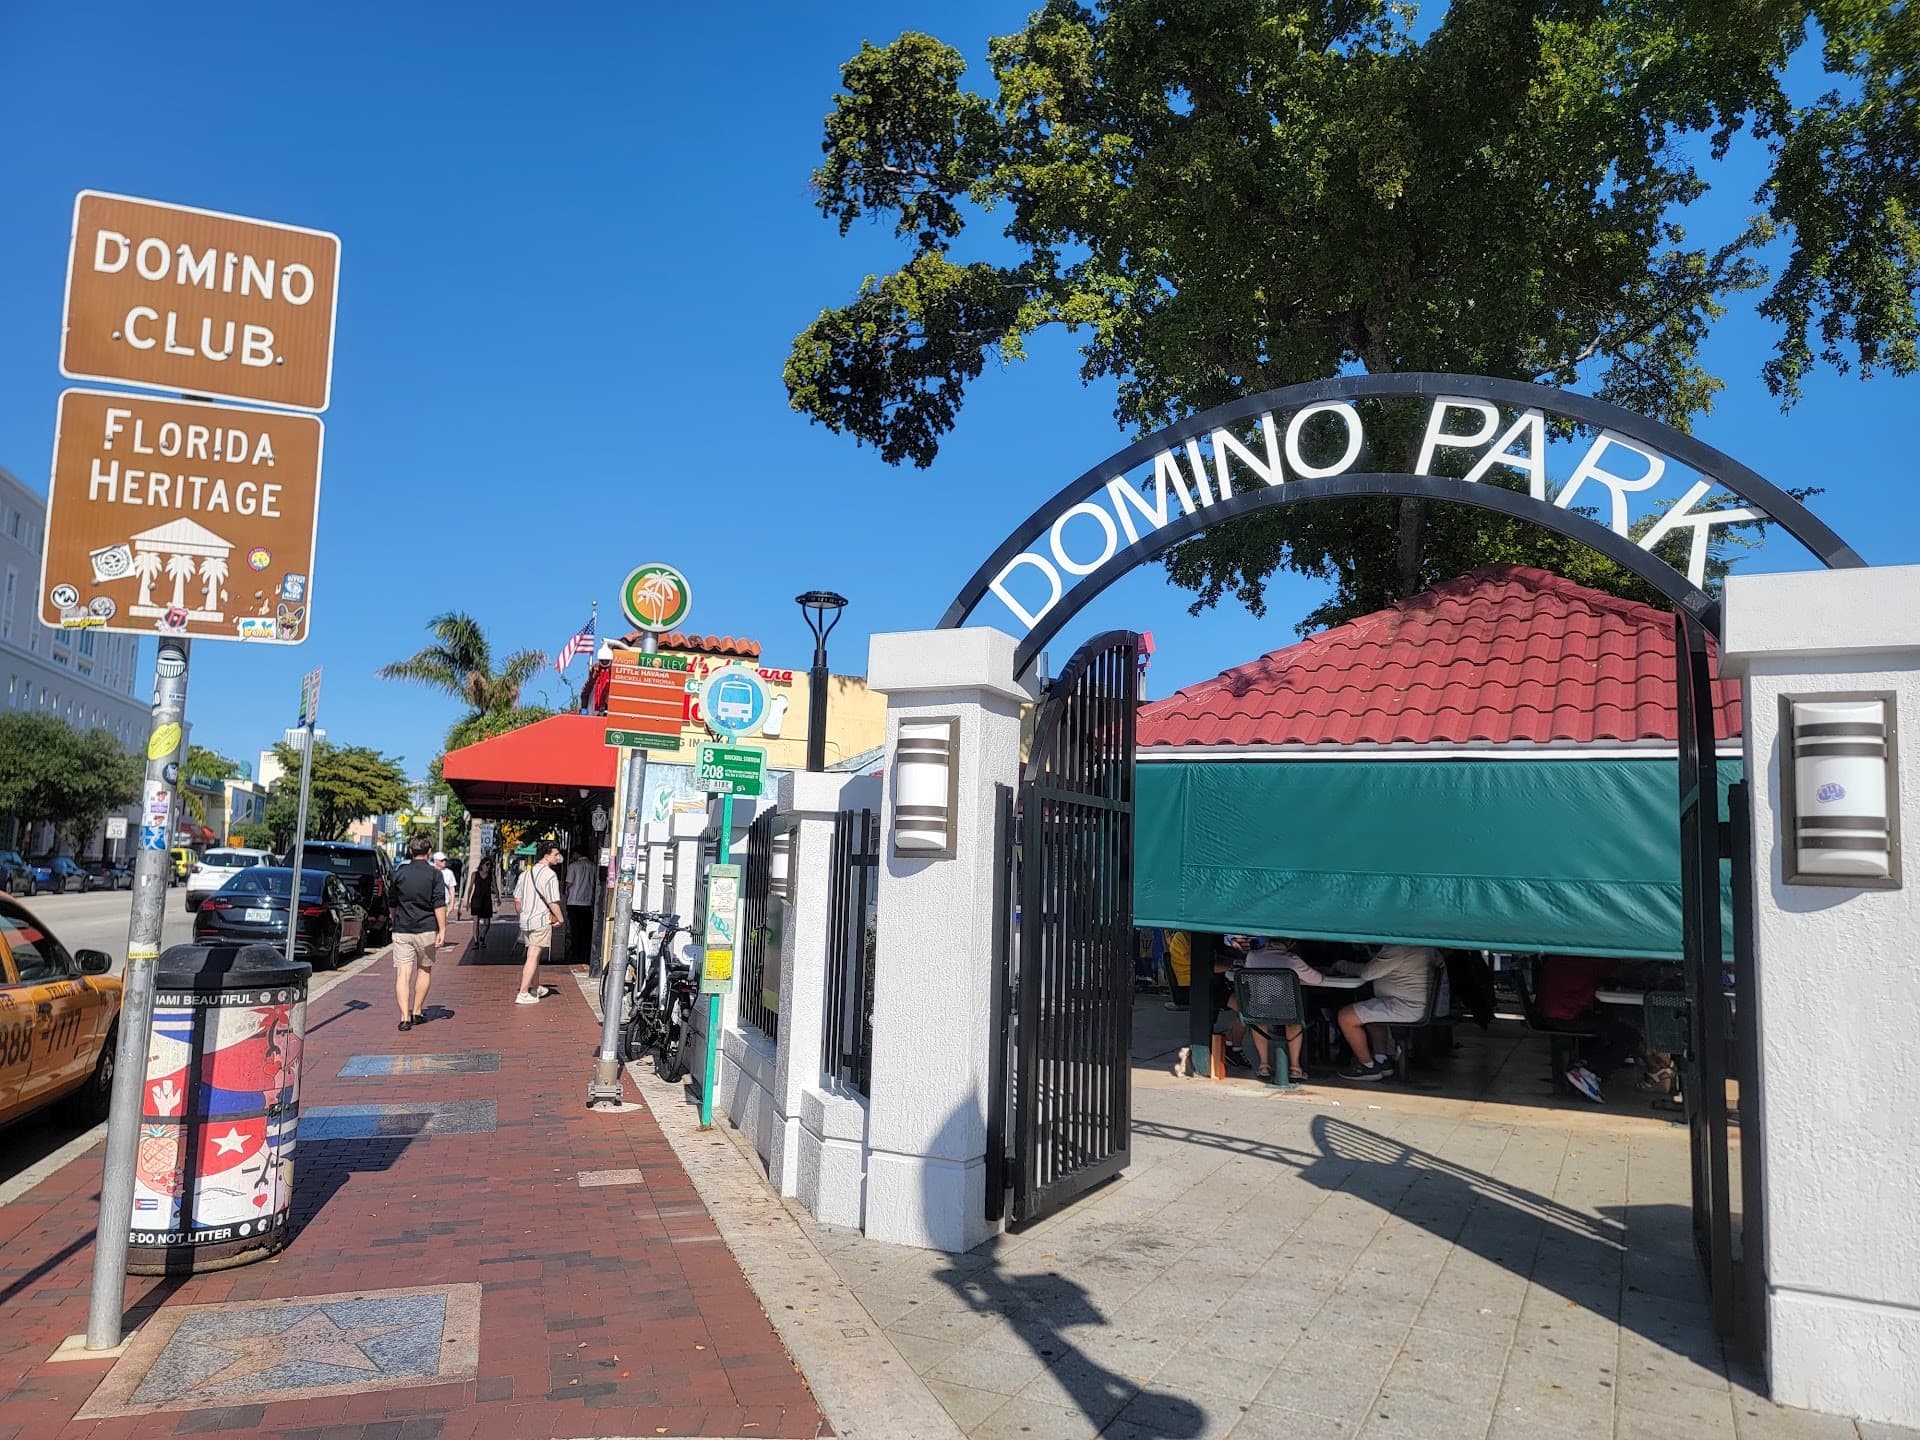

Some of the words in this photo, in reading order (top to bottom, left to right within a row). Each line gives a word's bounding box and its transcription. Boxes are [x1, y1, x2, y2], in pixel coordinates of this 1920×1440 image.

[94, 229, 315, 305] DOMINO
[124, 306, 274, 367] CLUB
[104, 408, 274, 466] FLORIDA
[88, 458, 282, 517] HERITAGE
[988, 399, 1363, 630] DOMINO
[1414, 395, 1770, 590] PARK
[616, 667, 640, 676] LITTLE
[641, 669, 670, 679] HAVANA
[702, 764, 724, 779] 208
[703, 749, 714, 763] 8
[155, 994, 180, 1006] IAMI
[183, 993, 253, 1006] BEAUTIFUL
[157, 1232, 184, 1244] NOT
[187, 1228, 232, 1243] LITTER
